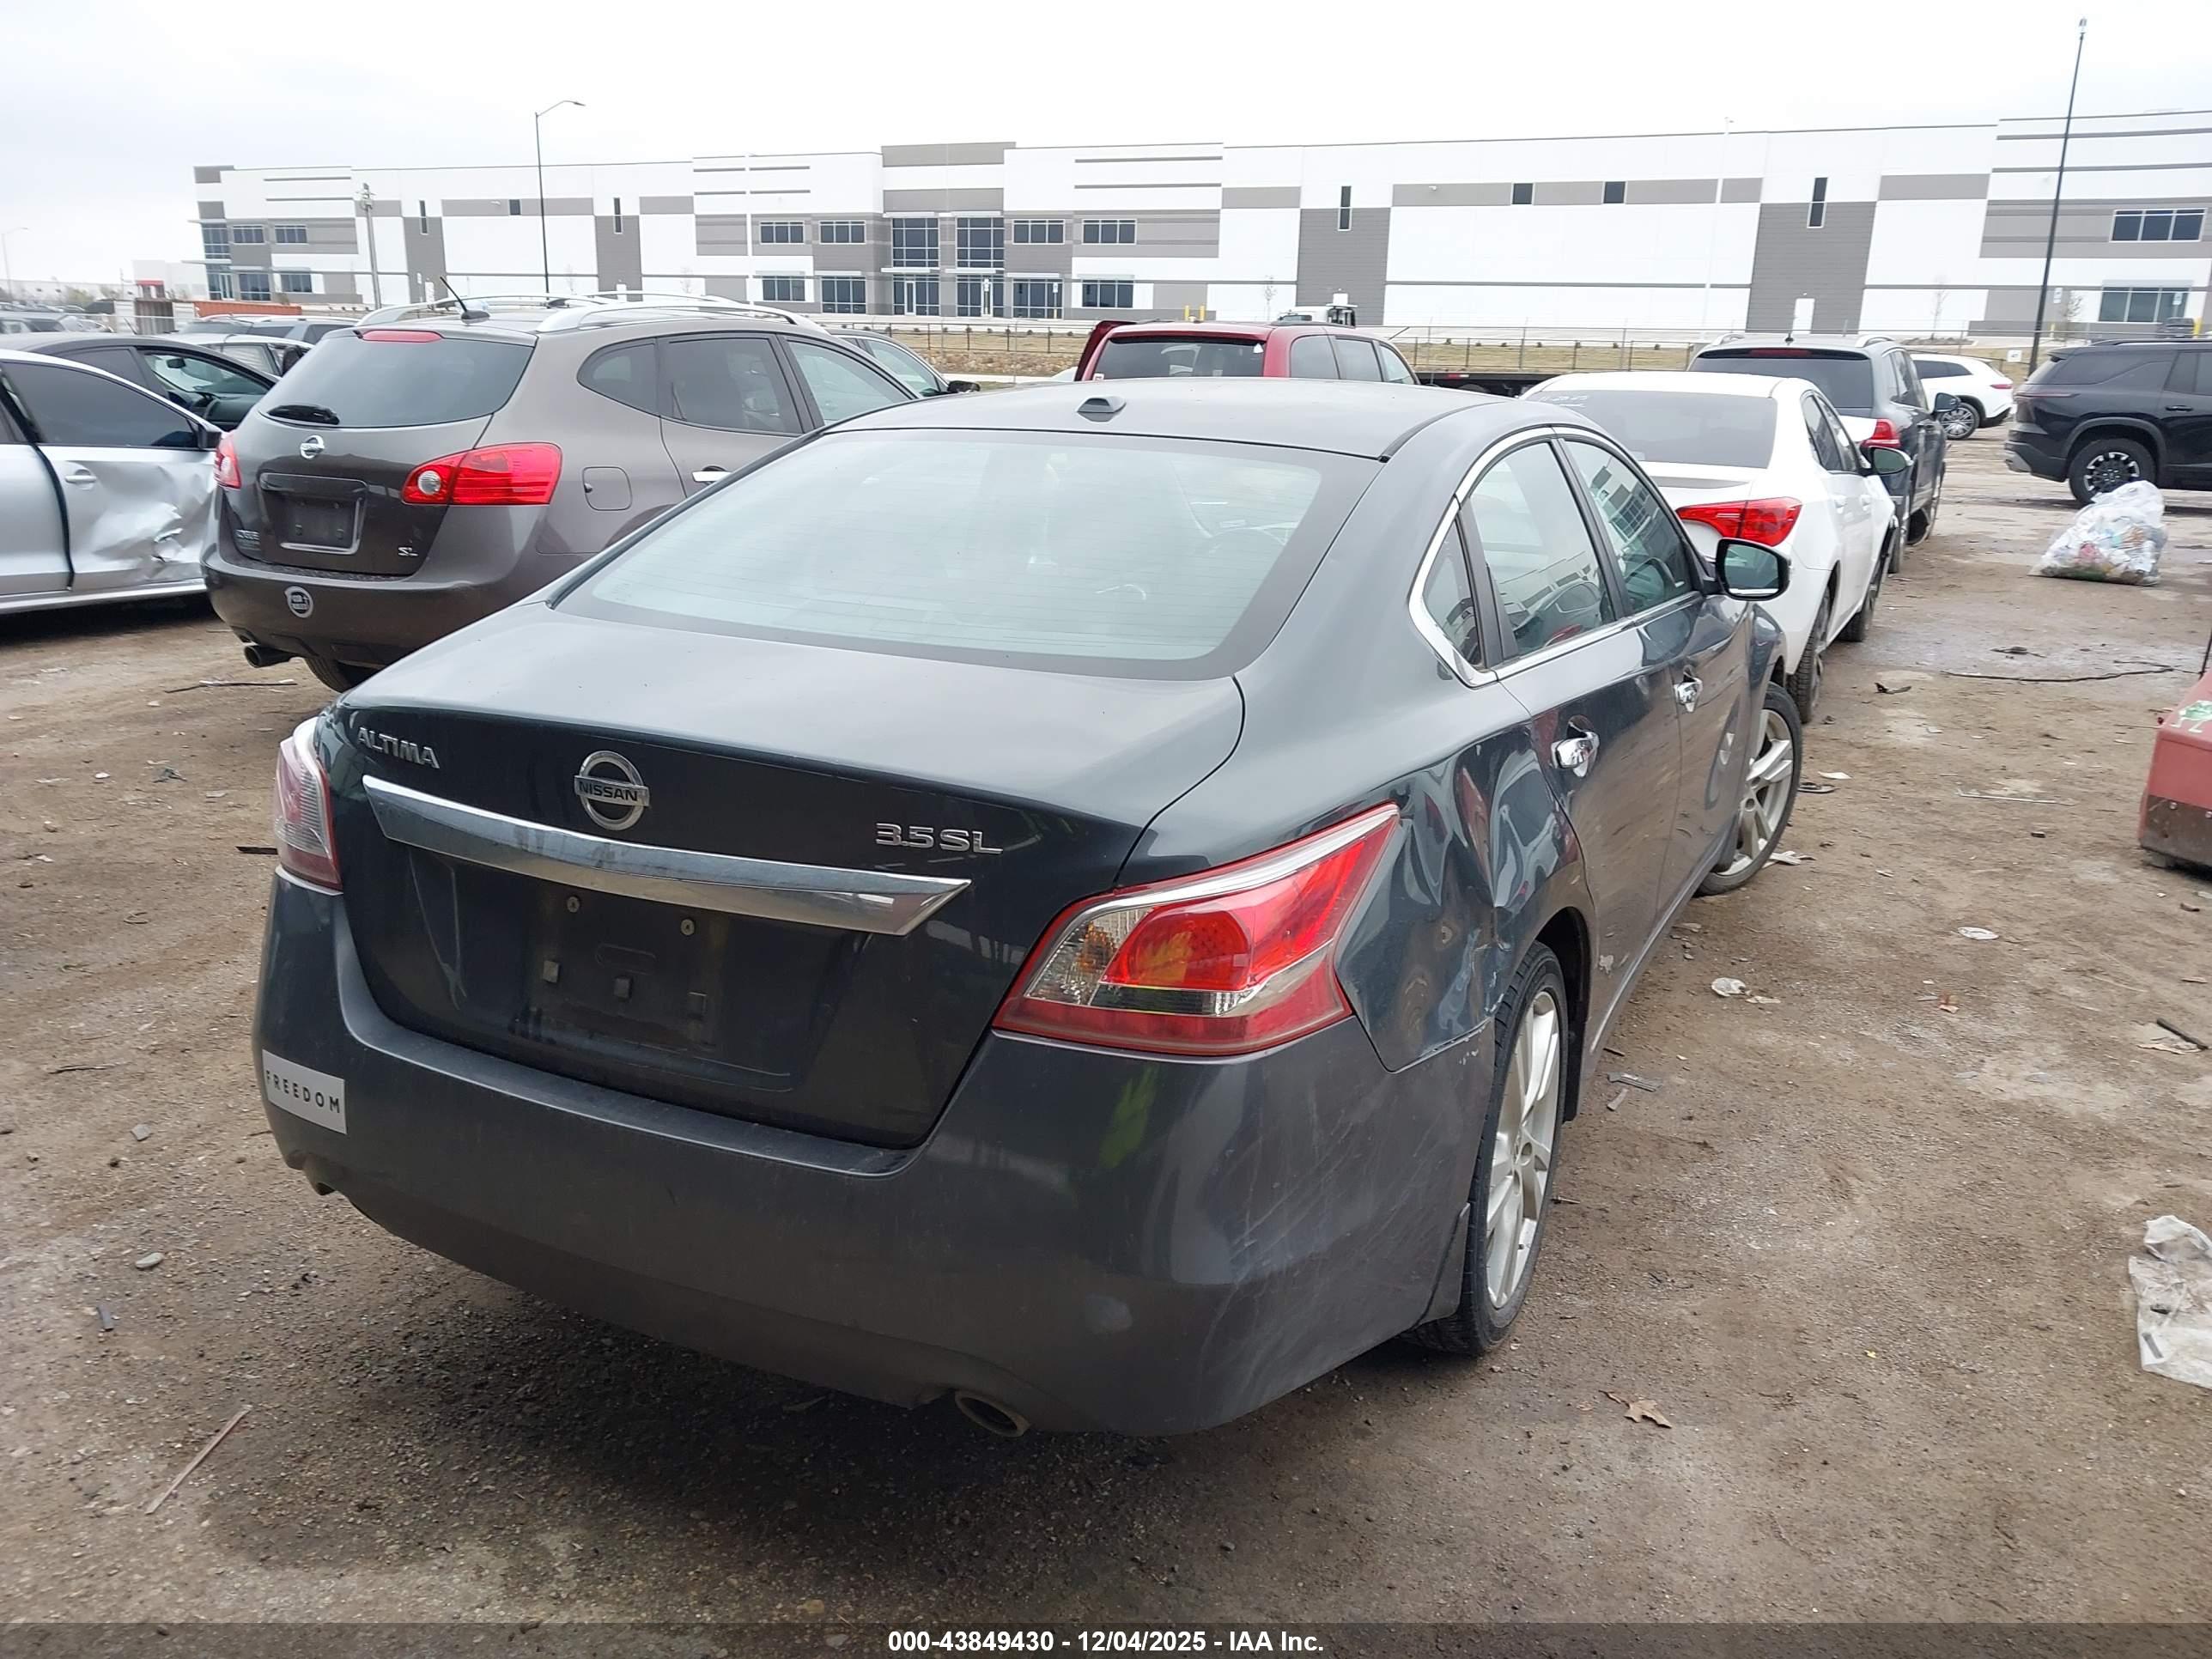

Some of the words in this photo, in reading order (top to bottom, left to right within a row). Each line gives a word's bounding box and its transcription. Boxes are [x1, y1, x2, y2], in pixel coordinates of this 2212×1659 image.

[358, 726, 441, 769] ALTIMA
[579, 781, 638, 802] NISSAN
[265, 1069, 341, 1114] FREEDOM
